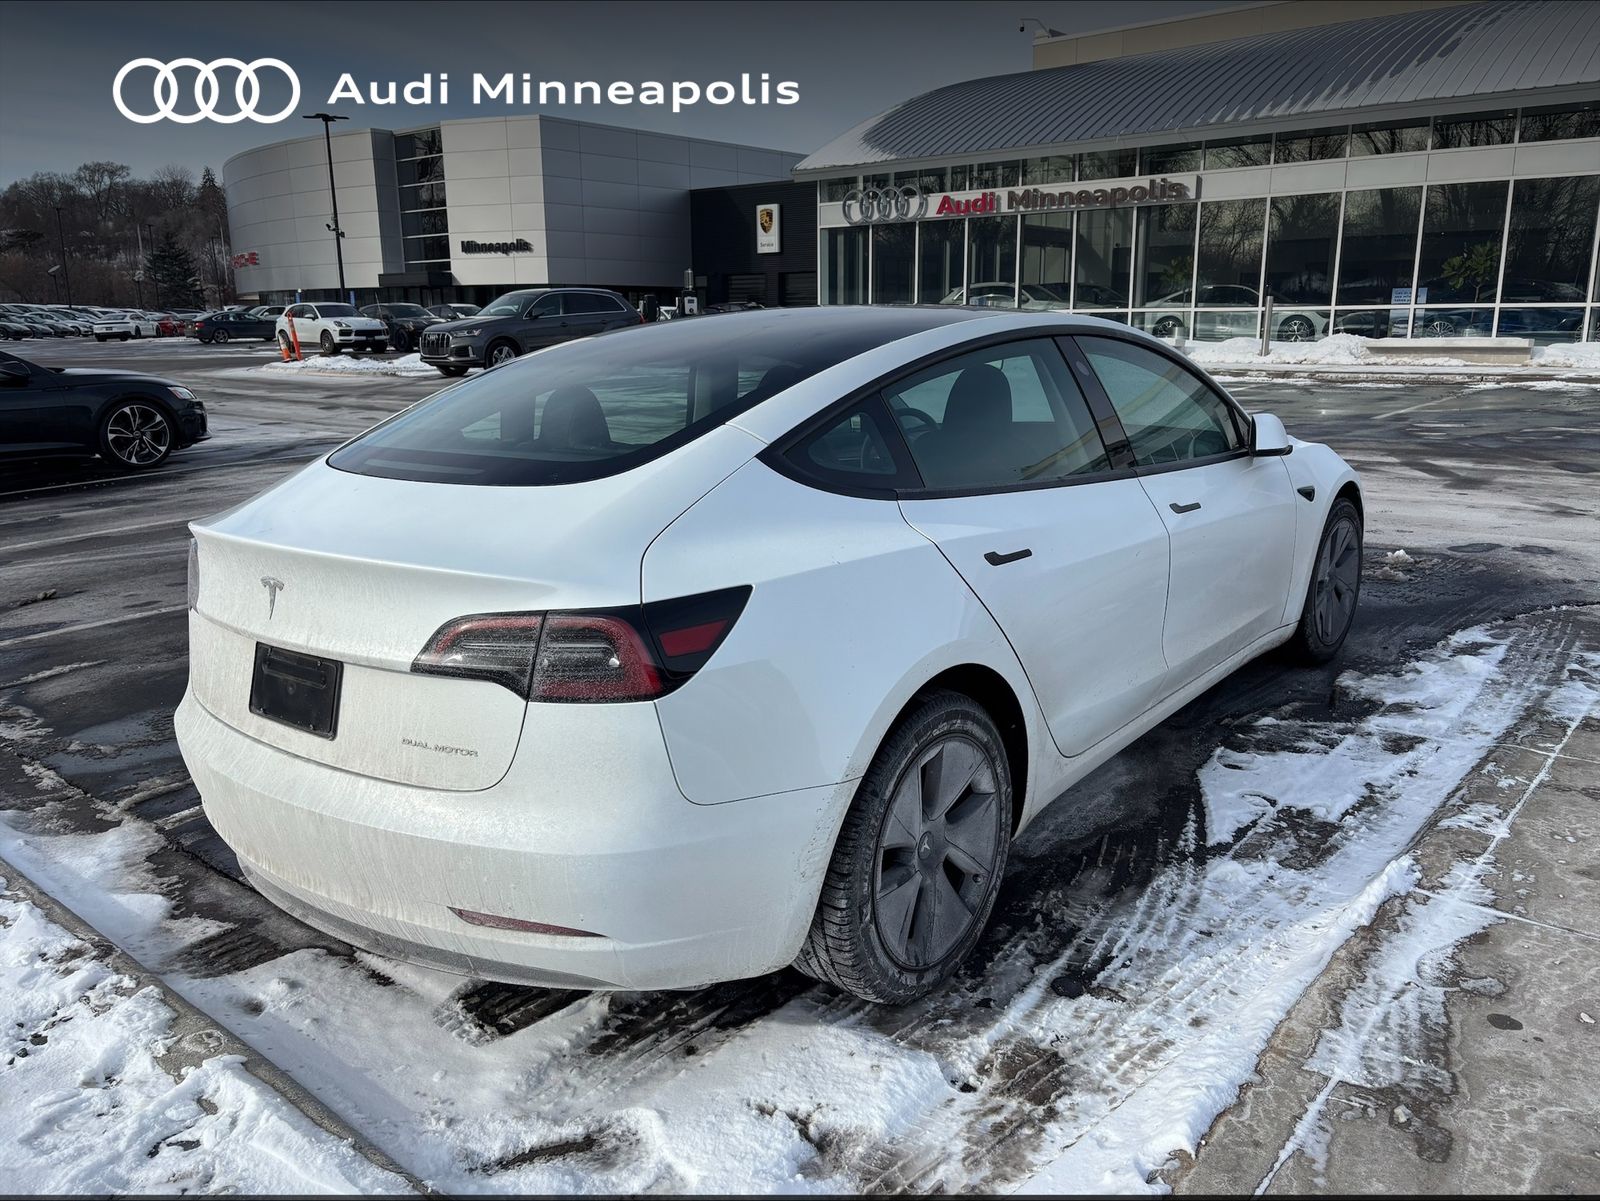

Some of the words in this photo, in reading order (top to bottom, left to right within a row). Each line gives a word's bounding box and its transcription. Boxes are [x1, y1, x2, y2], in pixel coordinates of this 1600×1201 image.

[935, 192, 996, 215] Audi
[1007, 178, 1188, 211] Minneapolis
[461, 238, 533, 256] Minneapolis
[401, 738, 432, 750] DUAL
[434, 744, 479, 758] MOTOR
